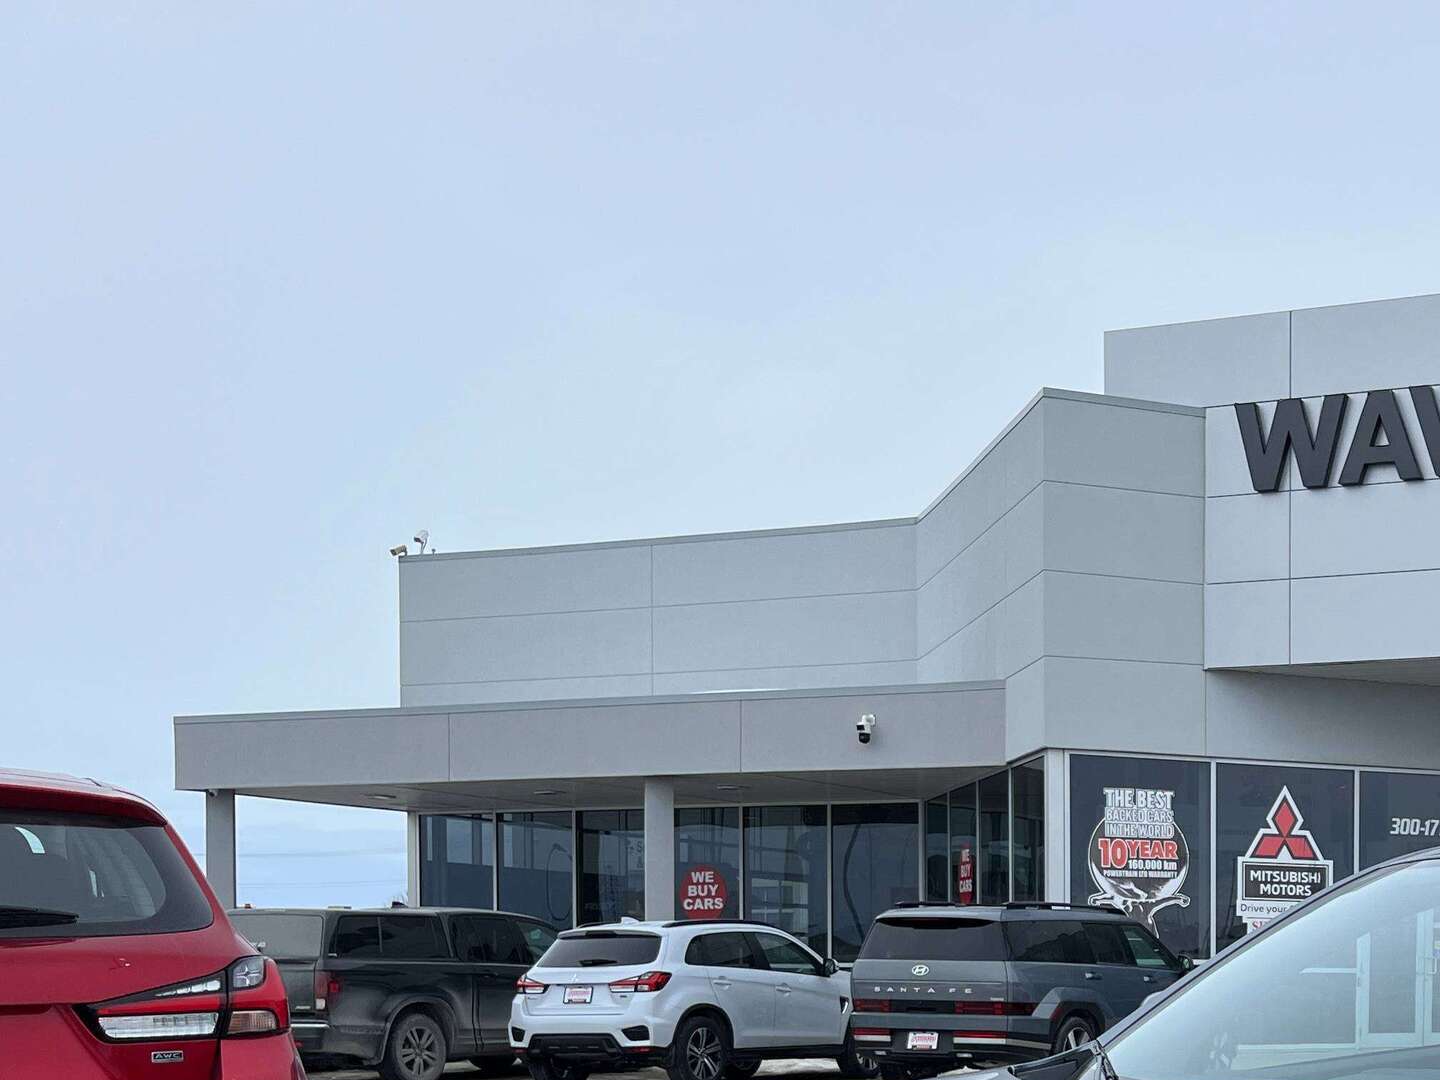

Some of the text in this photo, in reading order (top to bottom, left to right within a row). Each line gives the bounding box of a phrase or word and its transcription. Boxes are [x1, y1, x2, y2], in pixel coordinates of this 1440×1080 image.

[1103, 788, 1175, 809] THE BEST
[1105, 808, 1174, 823] BACKED CARS
[1106, 823, 1174, 838] IN THE WORLD
[1098, 838, 1178, 868] 10 YEAR
[960, 864, 971, 878] BUY
[1128, 860, 1177, 870] 160,000 km
[691, 872, 714, 883] WE
[1250, 870, 1321, 883] MITSUBISHI
[688, 884, 719, 897] BUY
[960, 880, 972, 893] CARS
[1260, 884, 1312, 896] MOTORS
[683, 898, 724, 910] CARS
[1240, 903, 1264, 913] Drive
[1266, 906, 1287, 914] your
